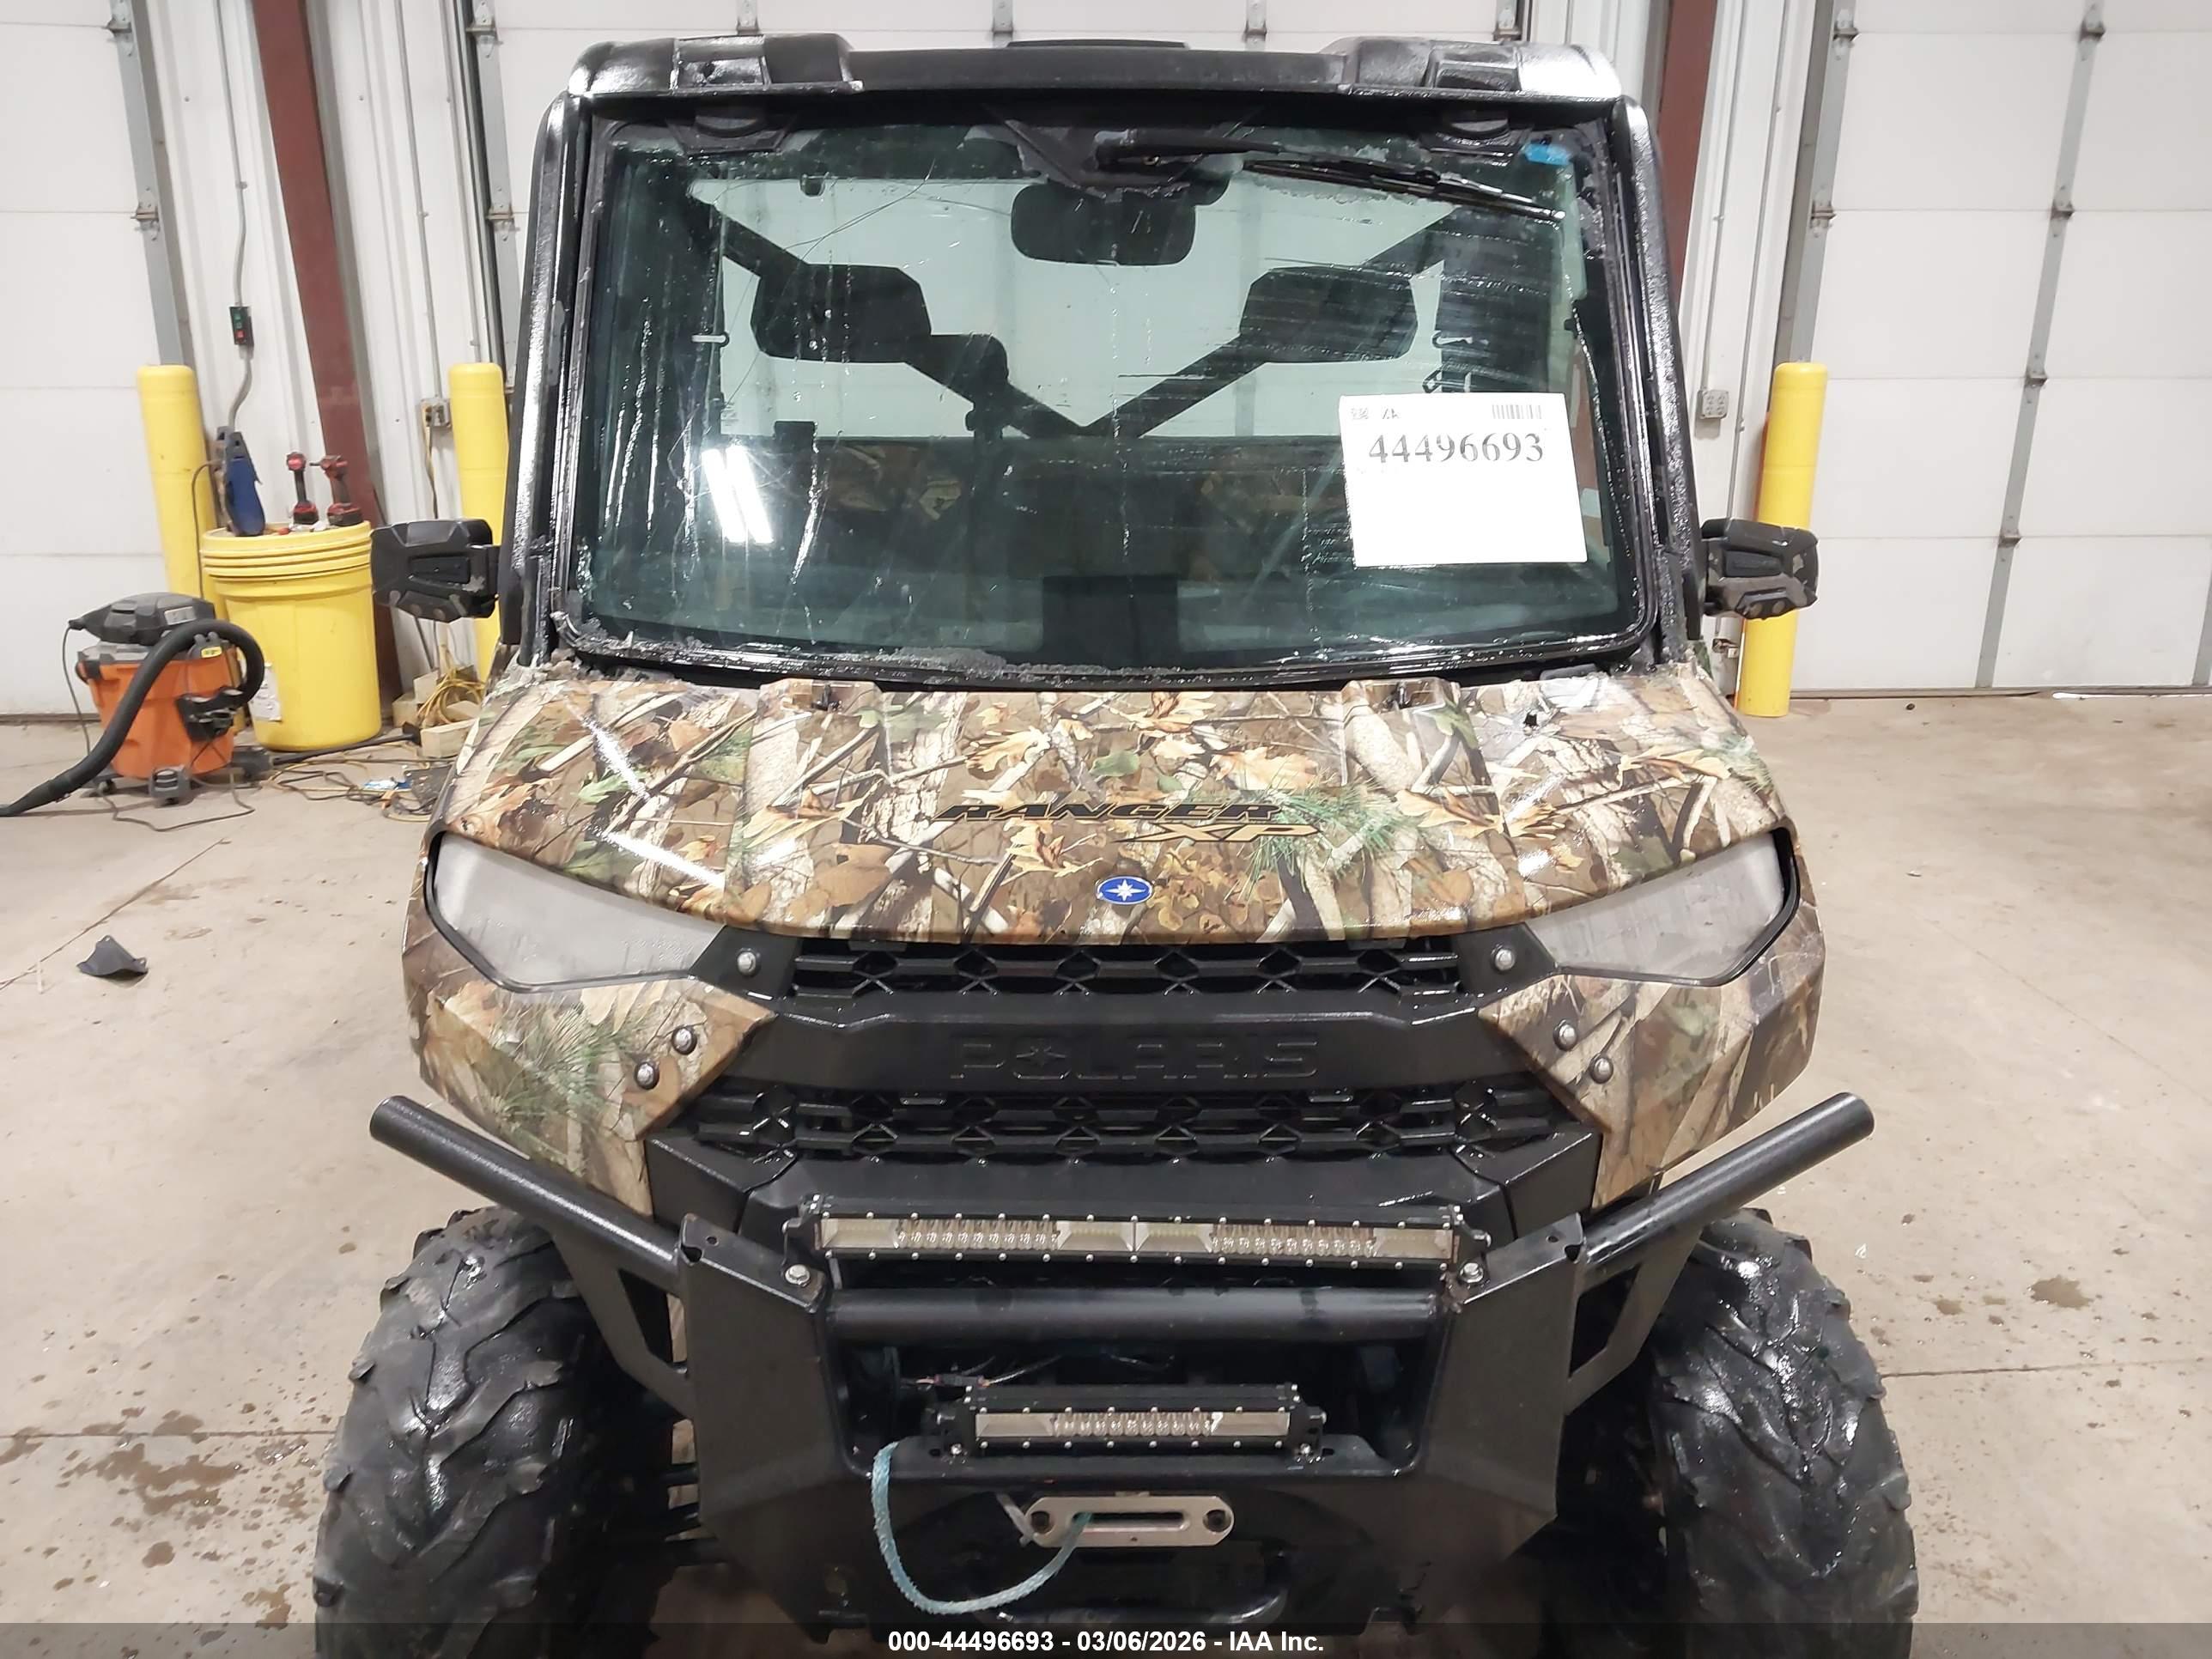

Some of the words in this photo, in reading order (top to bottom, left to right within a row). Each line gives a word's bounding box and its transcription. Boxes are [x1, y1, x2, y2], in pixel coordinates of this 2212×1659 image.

[1368, 432, 1543, 463] 44496693
[932, 802, 1283, 822] RANGER
[1113, 821, 1321, 843] XP
[950, 1035, 1319, 1079] POLARIS
